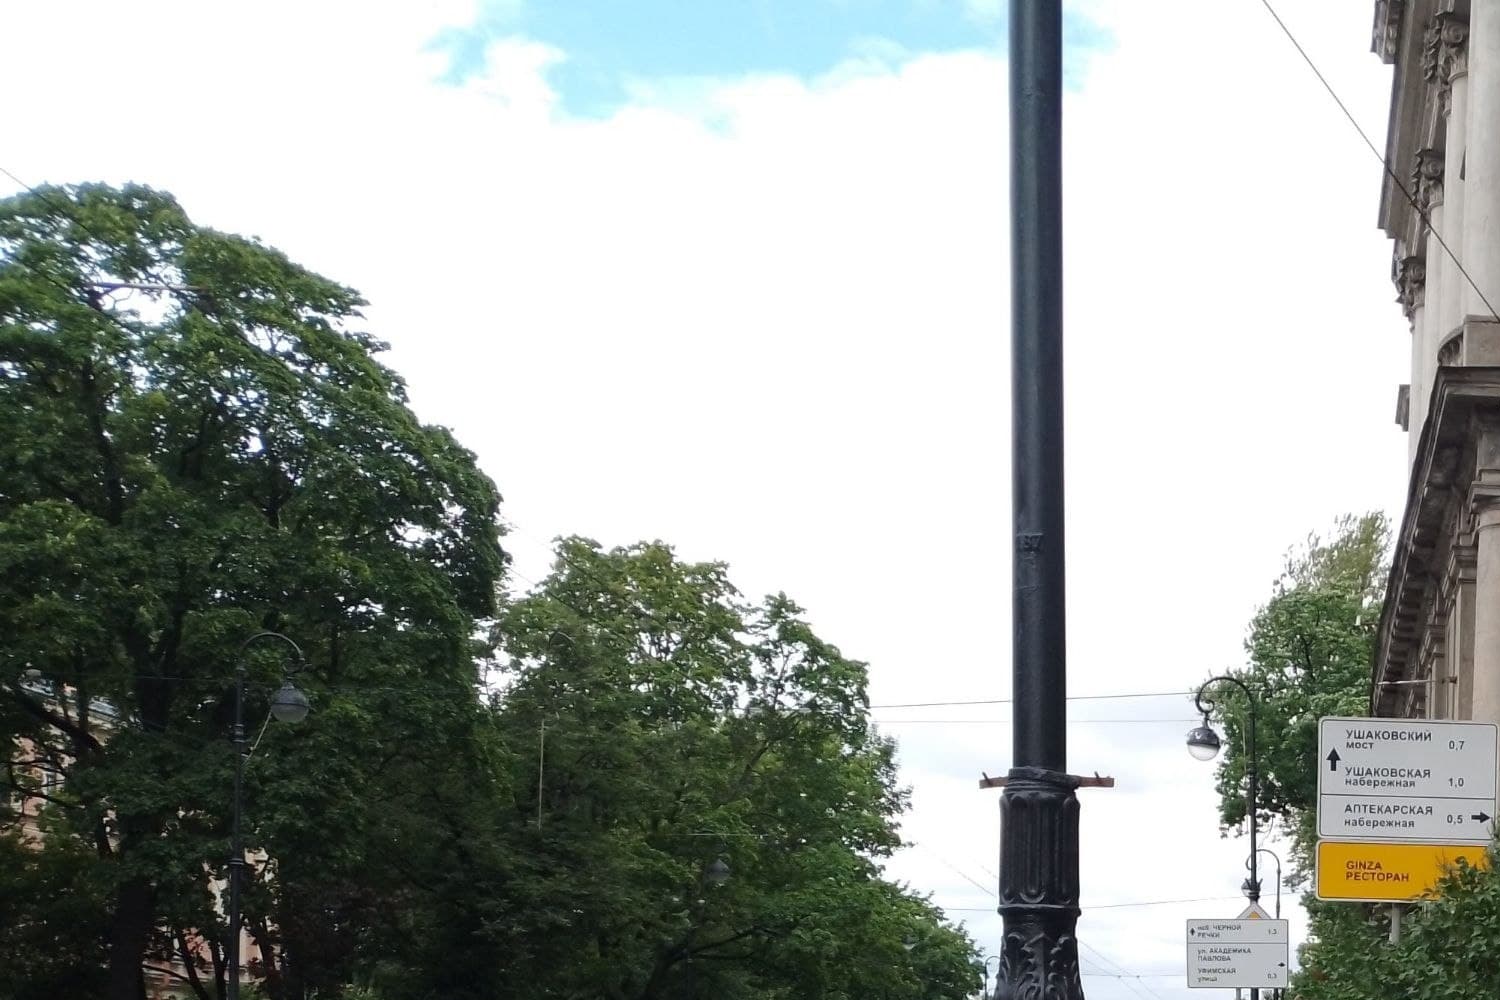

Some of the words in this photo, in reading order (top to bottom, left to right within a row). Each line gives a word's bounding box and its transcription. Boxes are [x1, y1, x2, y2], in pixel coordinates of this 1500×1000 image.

[1345, 729, 1432, 742] УШАКОВСКИЙ
[1346, 742, 1374, 750] мост
[1448, 740, 1465, 751] 0,7
[1345, 767, 1431, 779] УШАКОВСКАЯ
[1345, 777, 1416, 788] набережная
[1448, 777, 1464, 788] 1,0
[1344, 804, 1433, 816] АПТЕКАРСКАЯ
[1344, 818, 1415, 829] набережная
[1446, 814, 1463, 825] 0,5
[1346, 860, 1382, 871] GINZA
[1345, 871, 1409, 882] РЕСТОРАН
